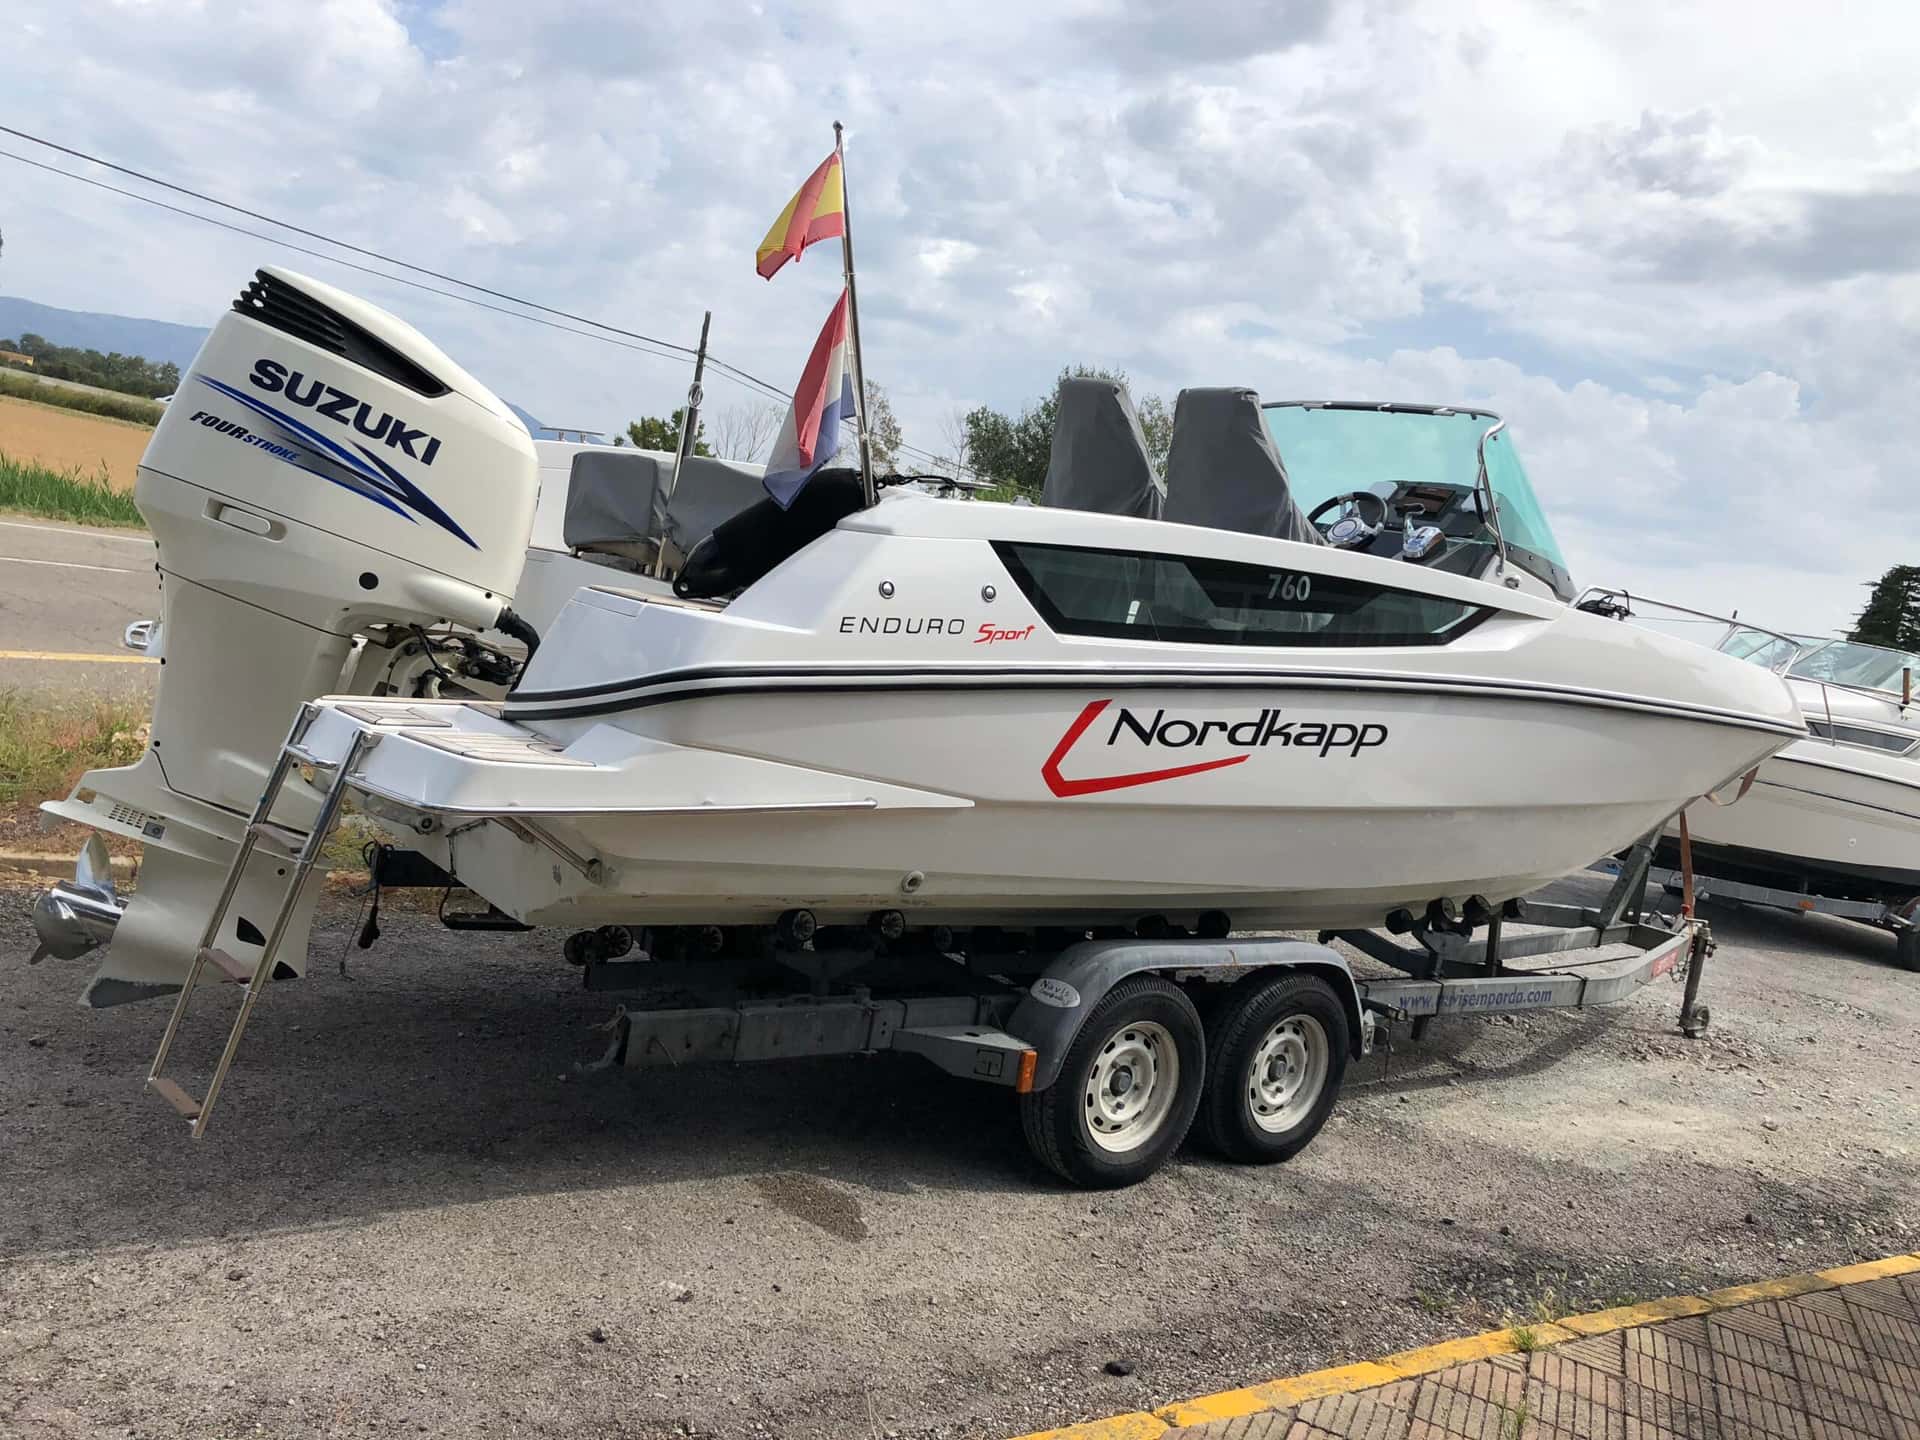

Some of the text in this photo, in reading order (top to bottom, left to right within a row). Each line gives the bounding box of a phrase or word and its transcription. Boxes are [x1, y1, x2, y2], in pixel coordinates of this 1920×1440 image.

[249, 359, 441, 466] SUZUKI
[1268, 574, 1311, 600] 760
[839, 616, 1035, 644] ENDURO Sport
[1107, 708, 1388, 758] Nordkapp
